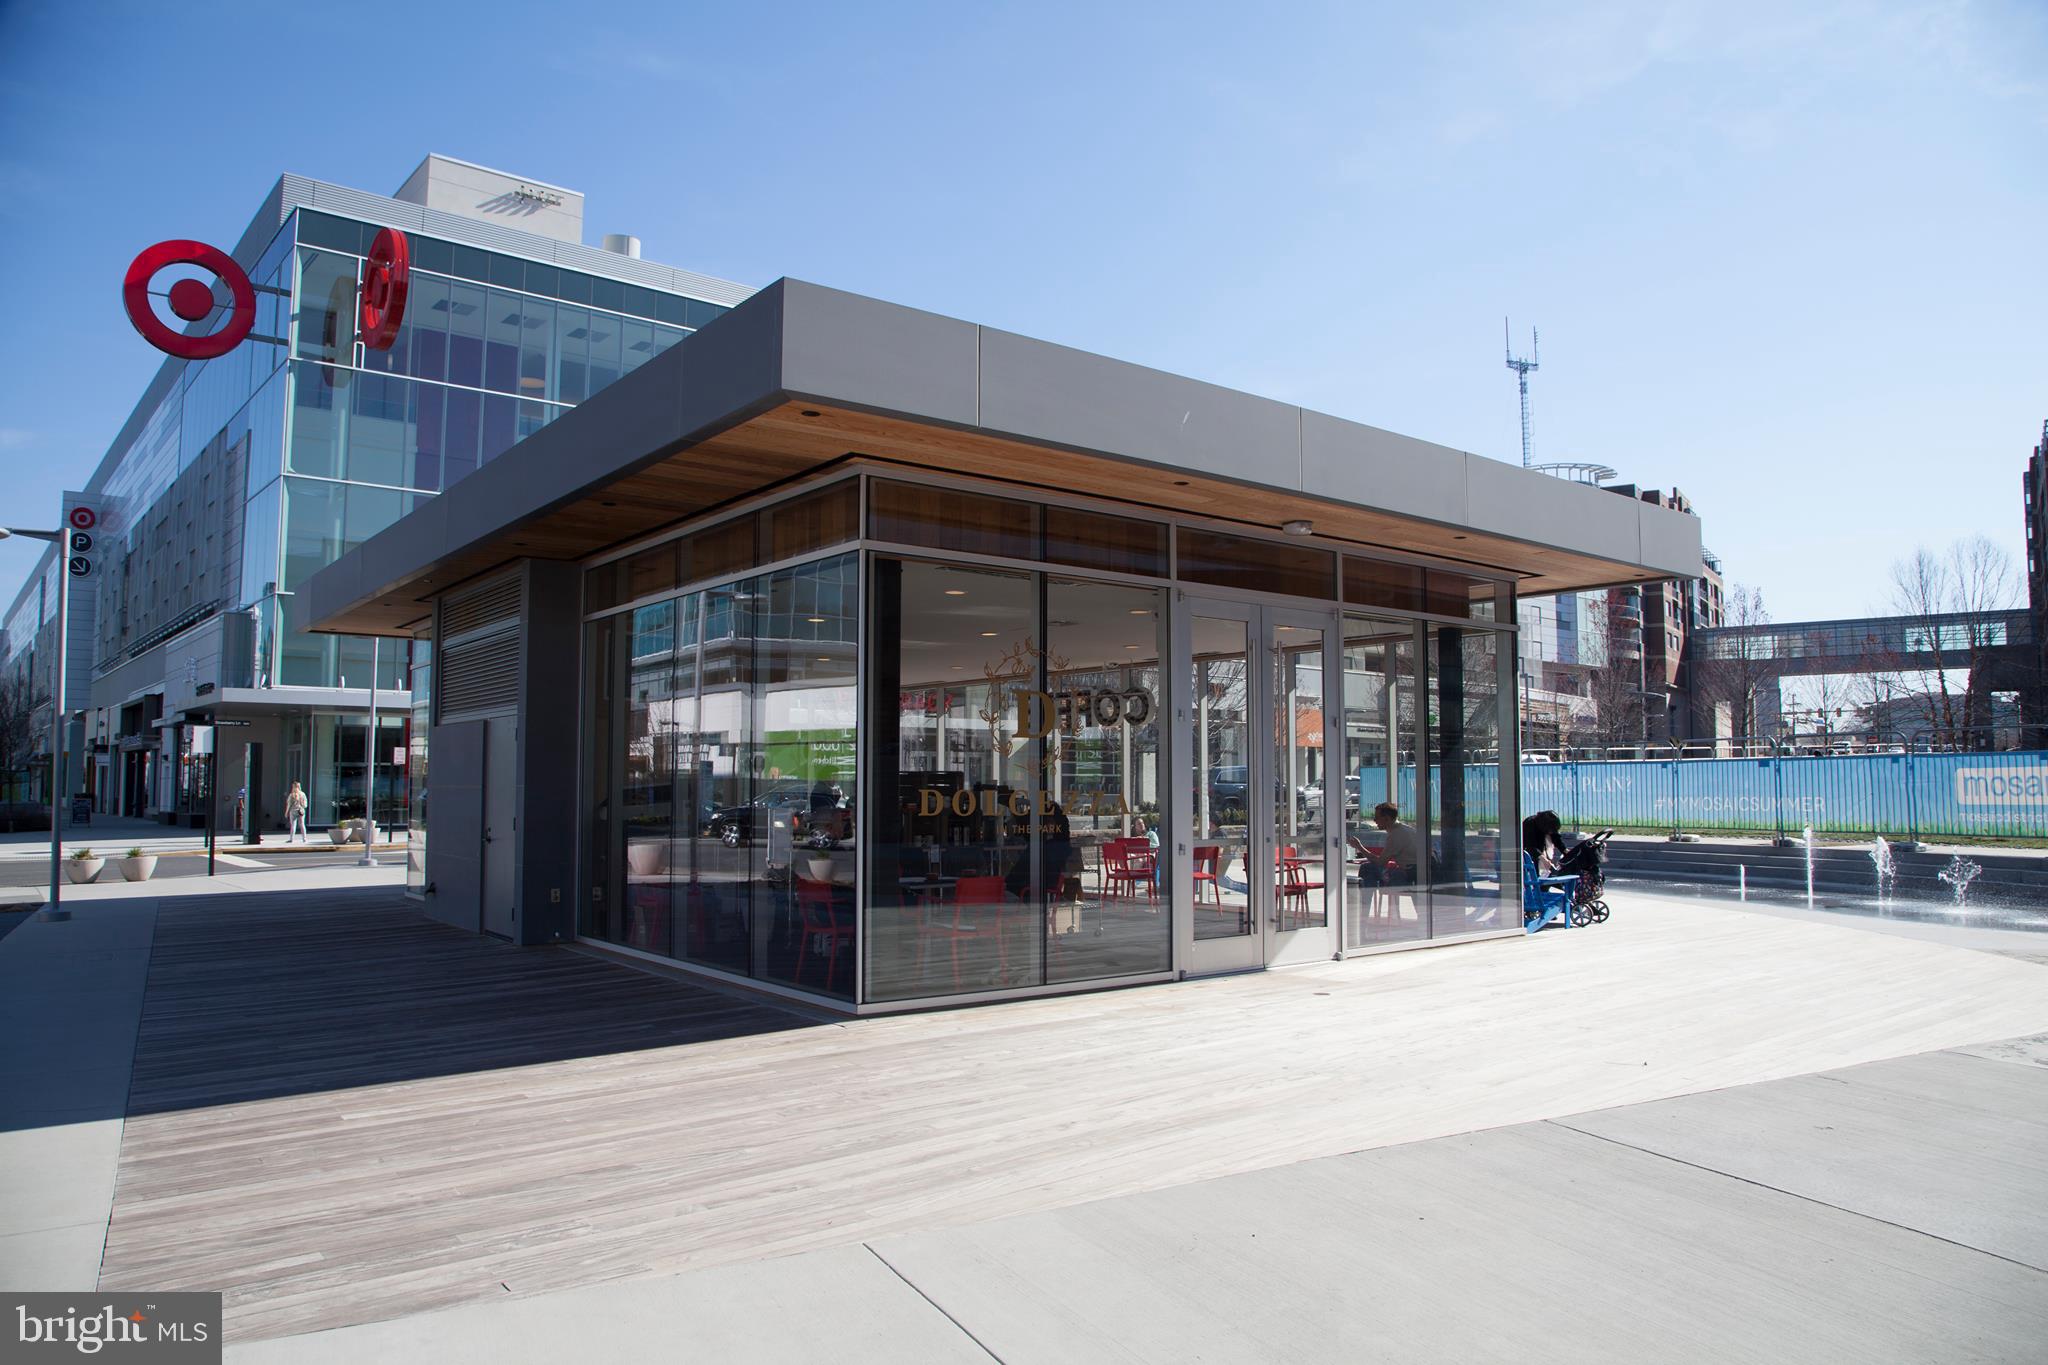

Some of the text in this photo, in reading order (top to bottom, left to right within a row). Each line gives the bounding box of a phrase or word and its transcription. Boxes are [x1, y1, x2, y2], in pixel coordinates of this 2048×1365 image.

[76, 536, 87, 548] P
[1011, 688, 1056, 739] D
[1582, 775, 1632, 793] PLAN?
[918, 789, 1132, 817] DOLCEZZA
[1012, 824, 1032, 834] THE
[1035, 824, 1062, 833] PARK
